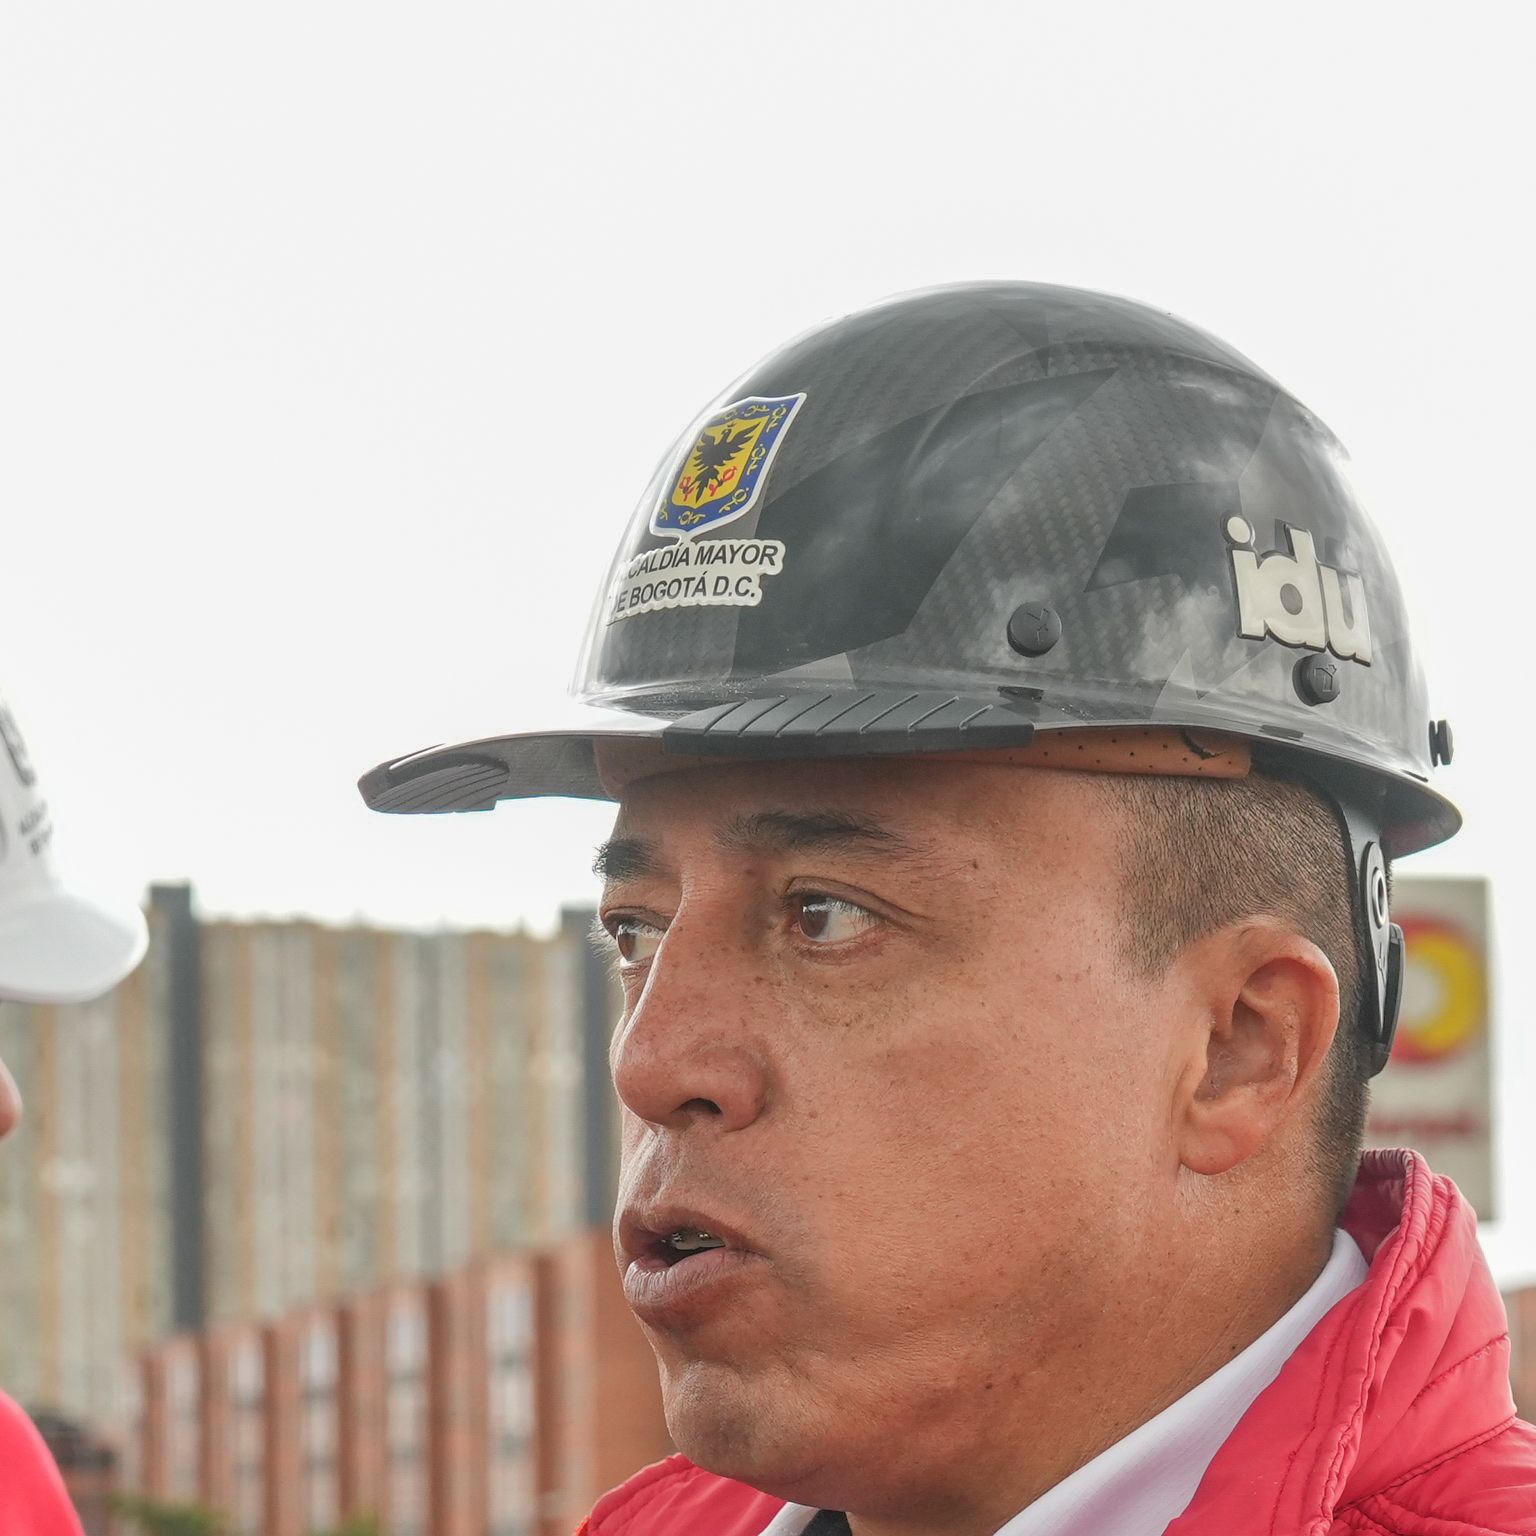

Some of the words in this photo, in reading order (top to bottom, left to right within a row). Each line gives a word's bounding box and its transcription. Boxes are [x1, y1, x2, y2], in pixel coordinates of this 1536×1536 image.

[626, 542, 690, 580] CALDÍA
[694, 543, 779, 567] MAYOR
[629, 571, 707, 608] BOGOTÁ
[712, 575, 756, 598] D.C.
[1224, 513, 1371, 665] idu
